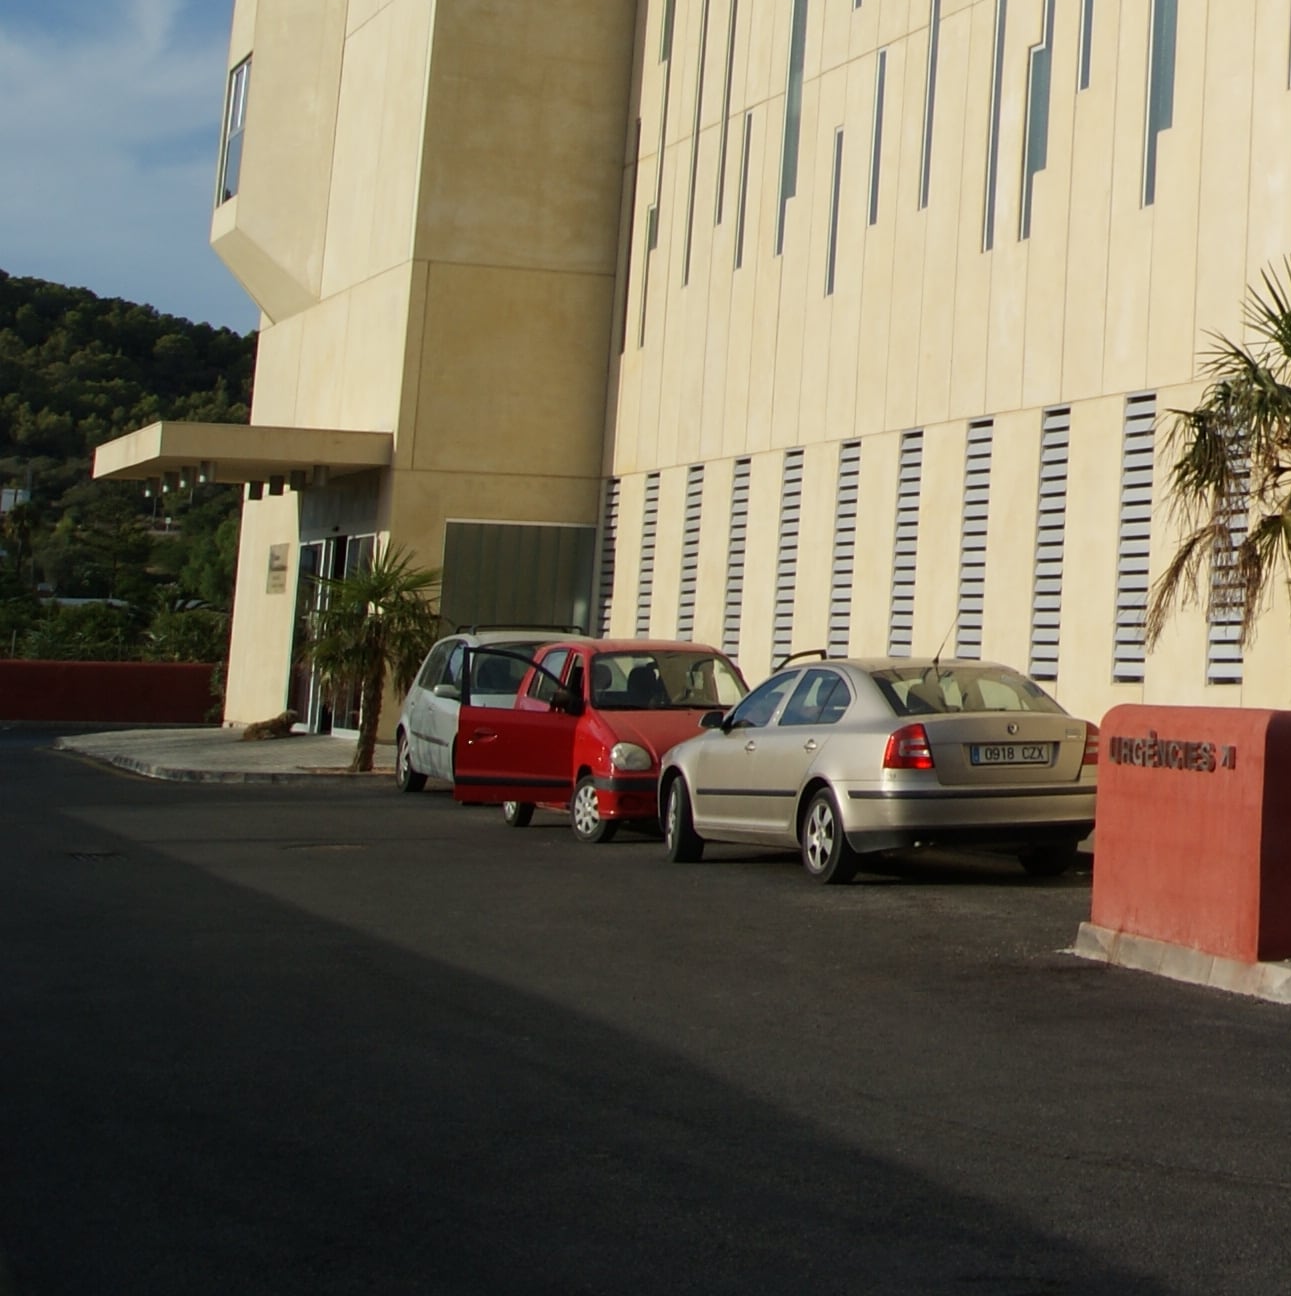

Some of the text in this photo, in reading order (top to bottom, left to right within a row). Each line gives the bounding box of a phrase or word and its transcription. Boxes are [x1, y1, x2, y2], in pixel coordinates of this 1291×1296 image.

[984, 746, 1044, 761] 0918 CZX
[1109, 730, 1216, 772] URGÈNCIES
